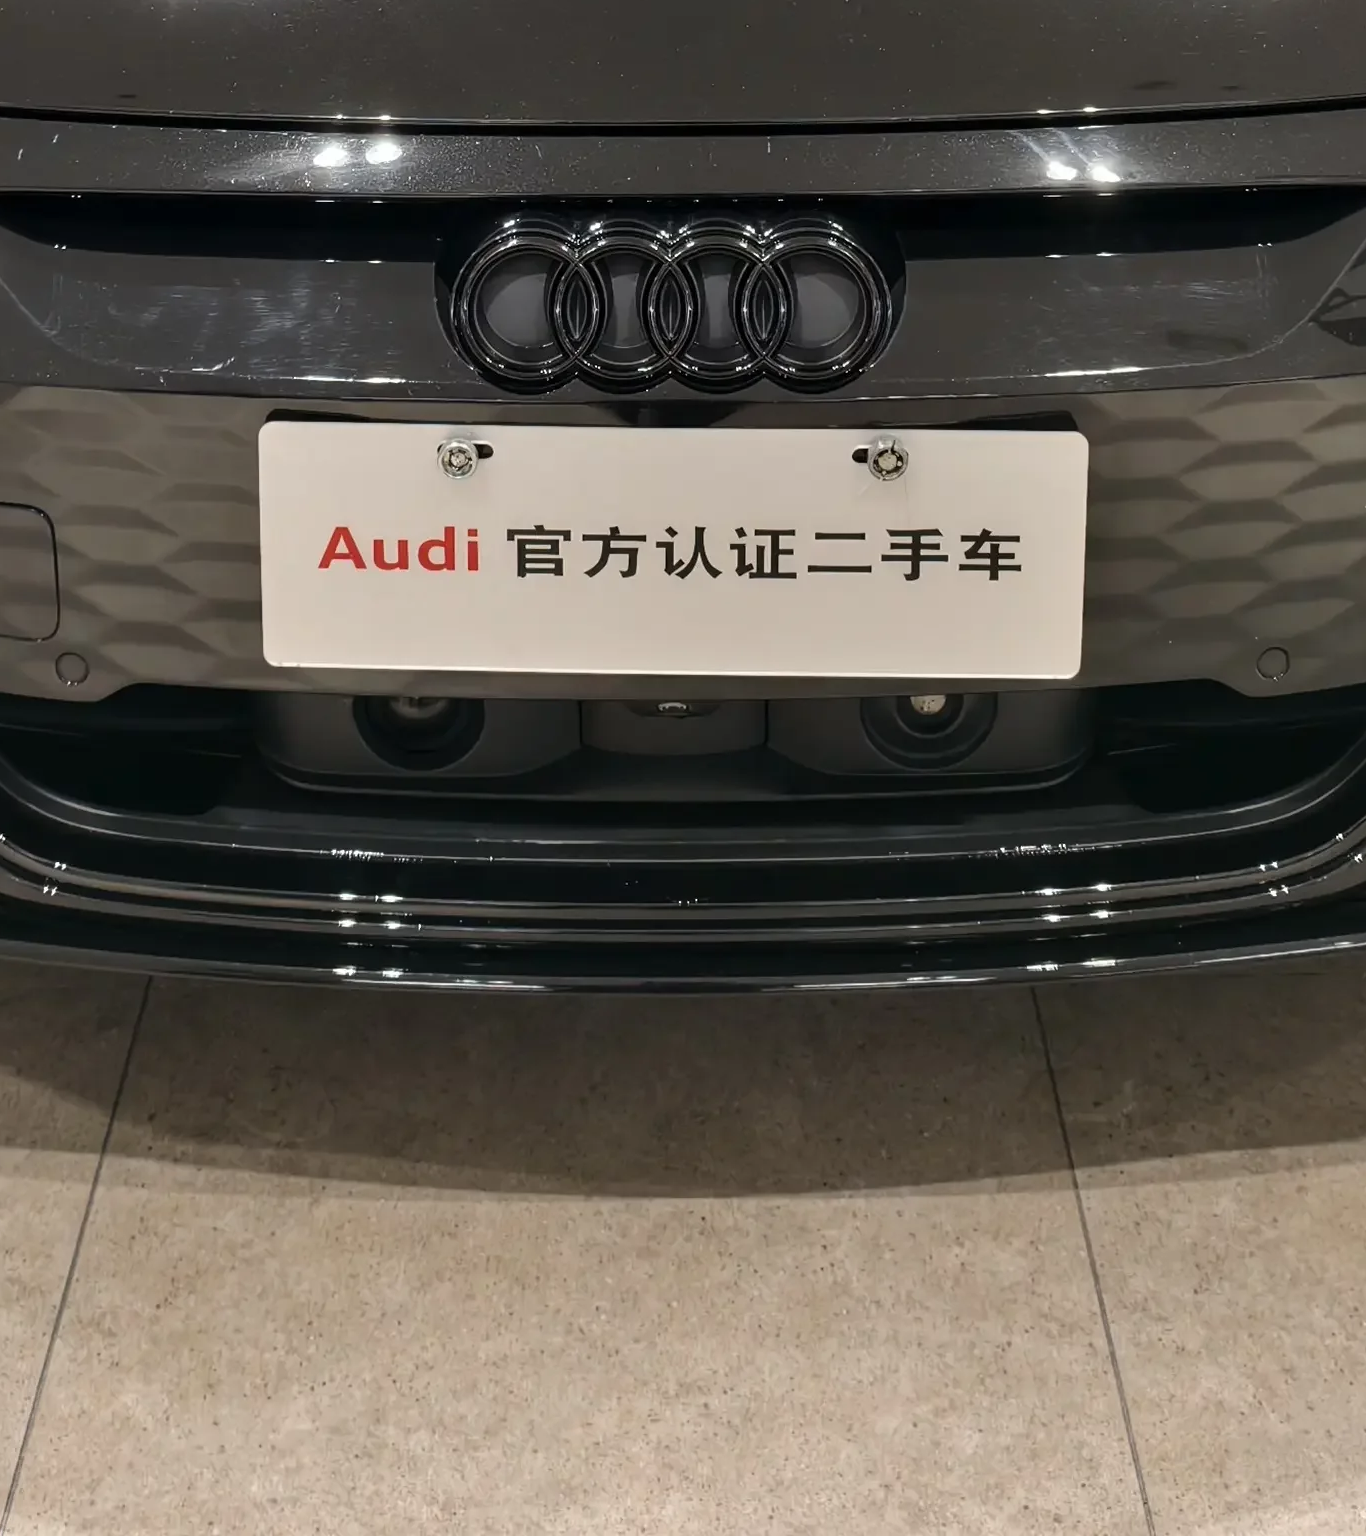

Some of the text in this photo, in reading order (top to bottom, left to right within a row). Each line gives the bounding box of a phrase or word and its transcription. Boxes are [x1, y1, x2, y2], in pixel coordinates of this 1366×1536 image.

[318, 524, 1023, 582] Audi 官方认证二手车
